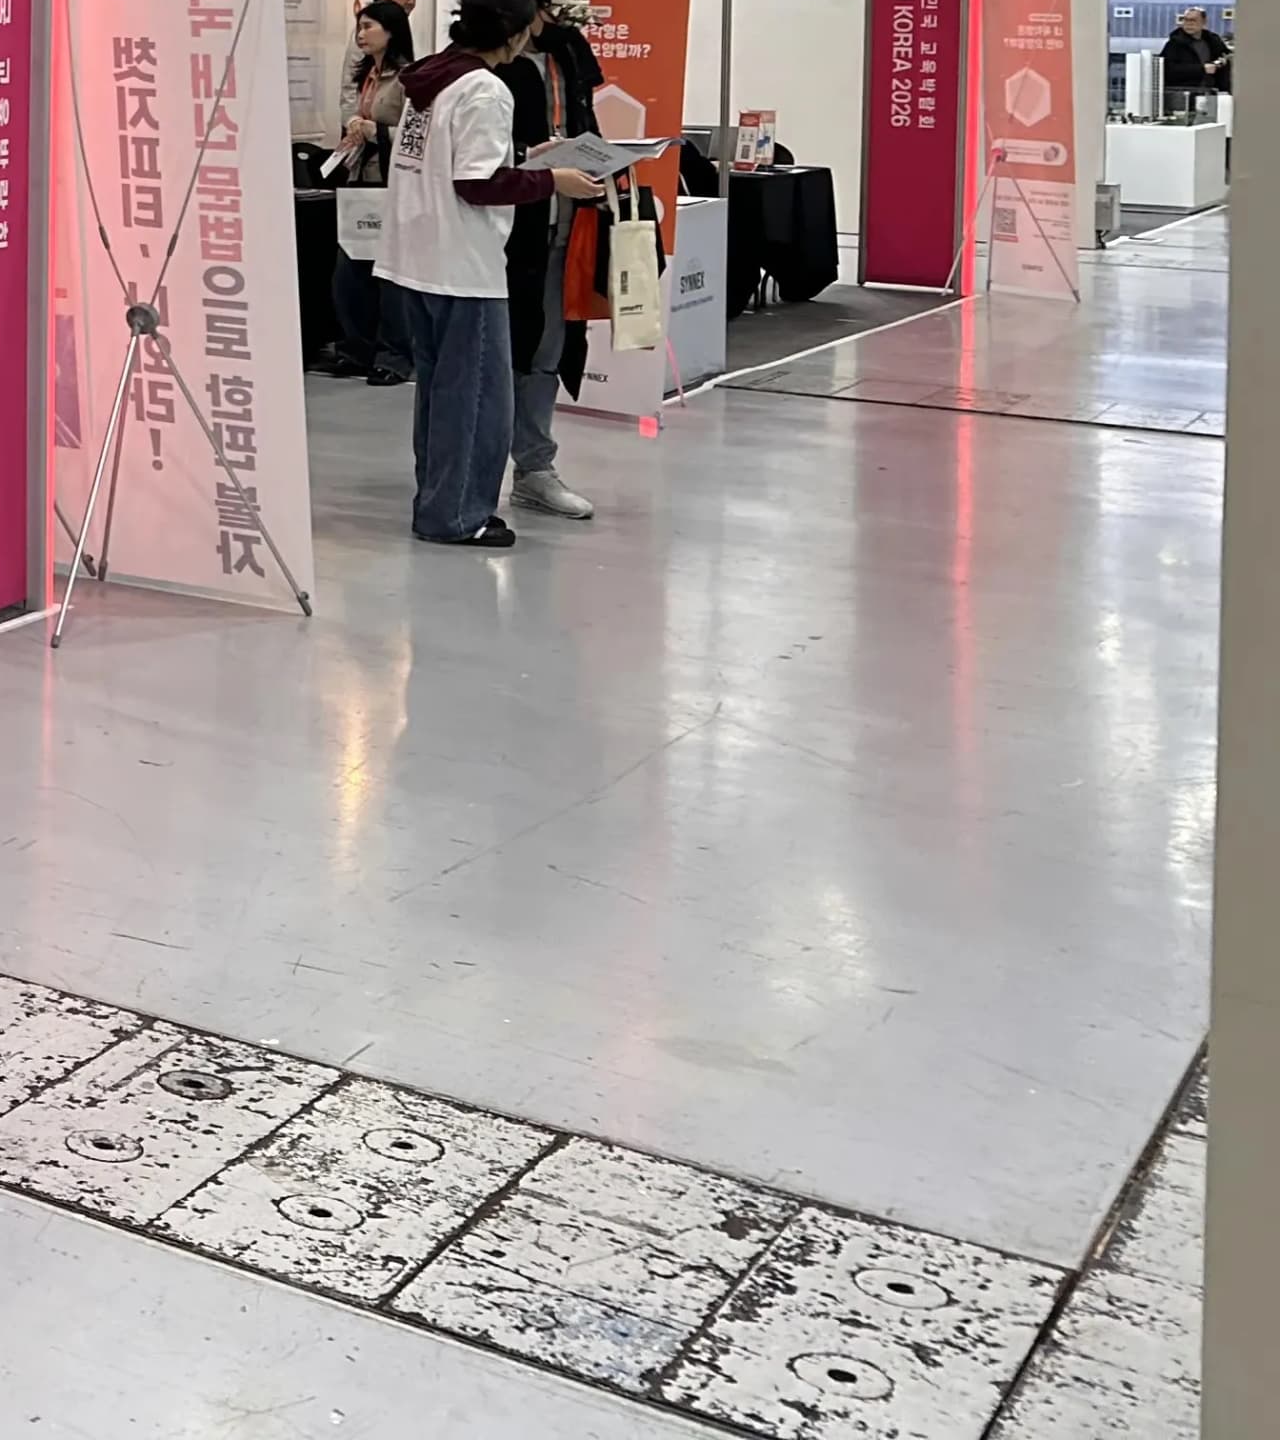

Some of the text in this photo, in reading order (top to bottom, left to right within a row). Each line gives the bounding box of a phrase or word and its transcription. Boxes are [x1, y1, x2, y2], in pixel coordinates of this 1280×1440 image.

[581, 23, 630, 40] 각형은
[892, 5, 915, 73] KOREA
[890, 75, 912, 128] 2026
[917, 41, 937, 130] 교육박람회
[680, 271, 705, 294] SYNNEX
